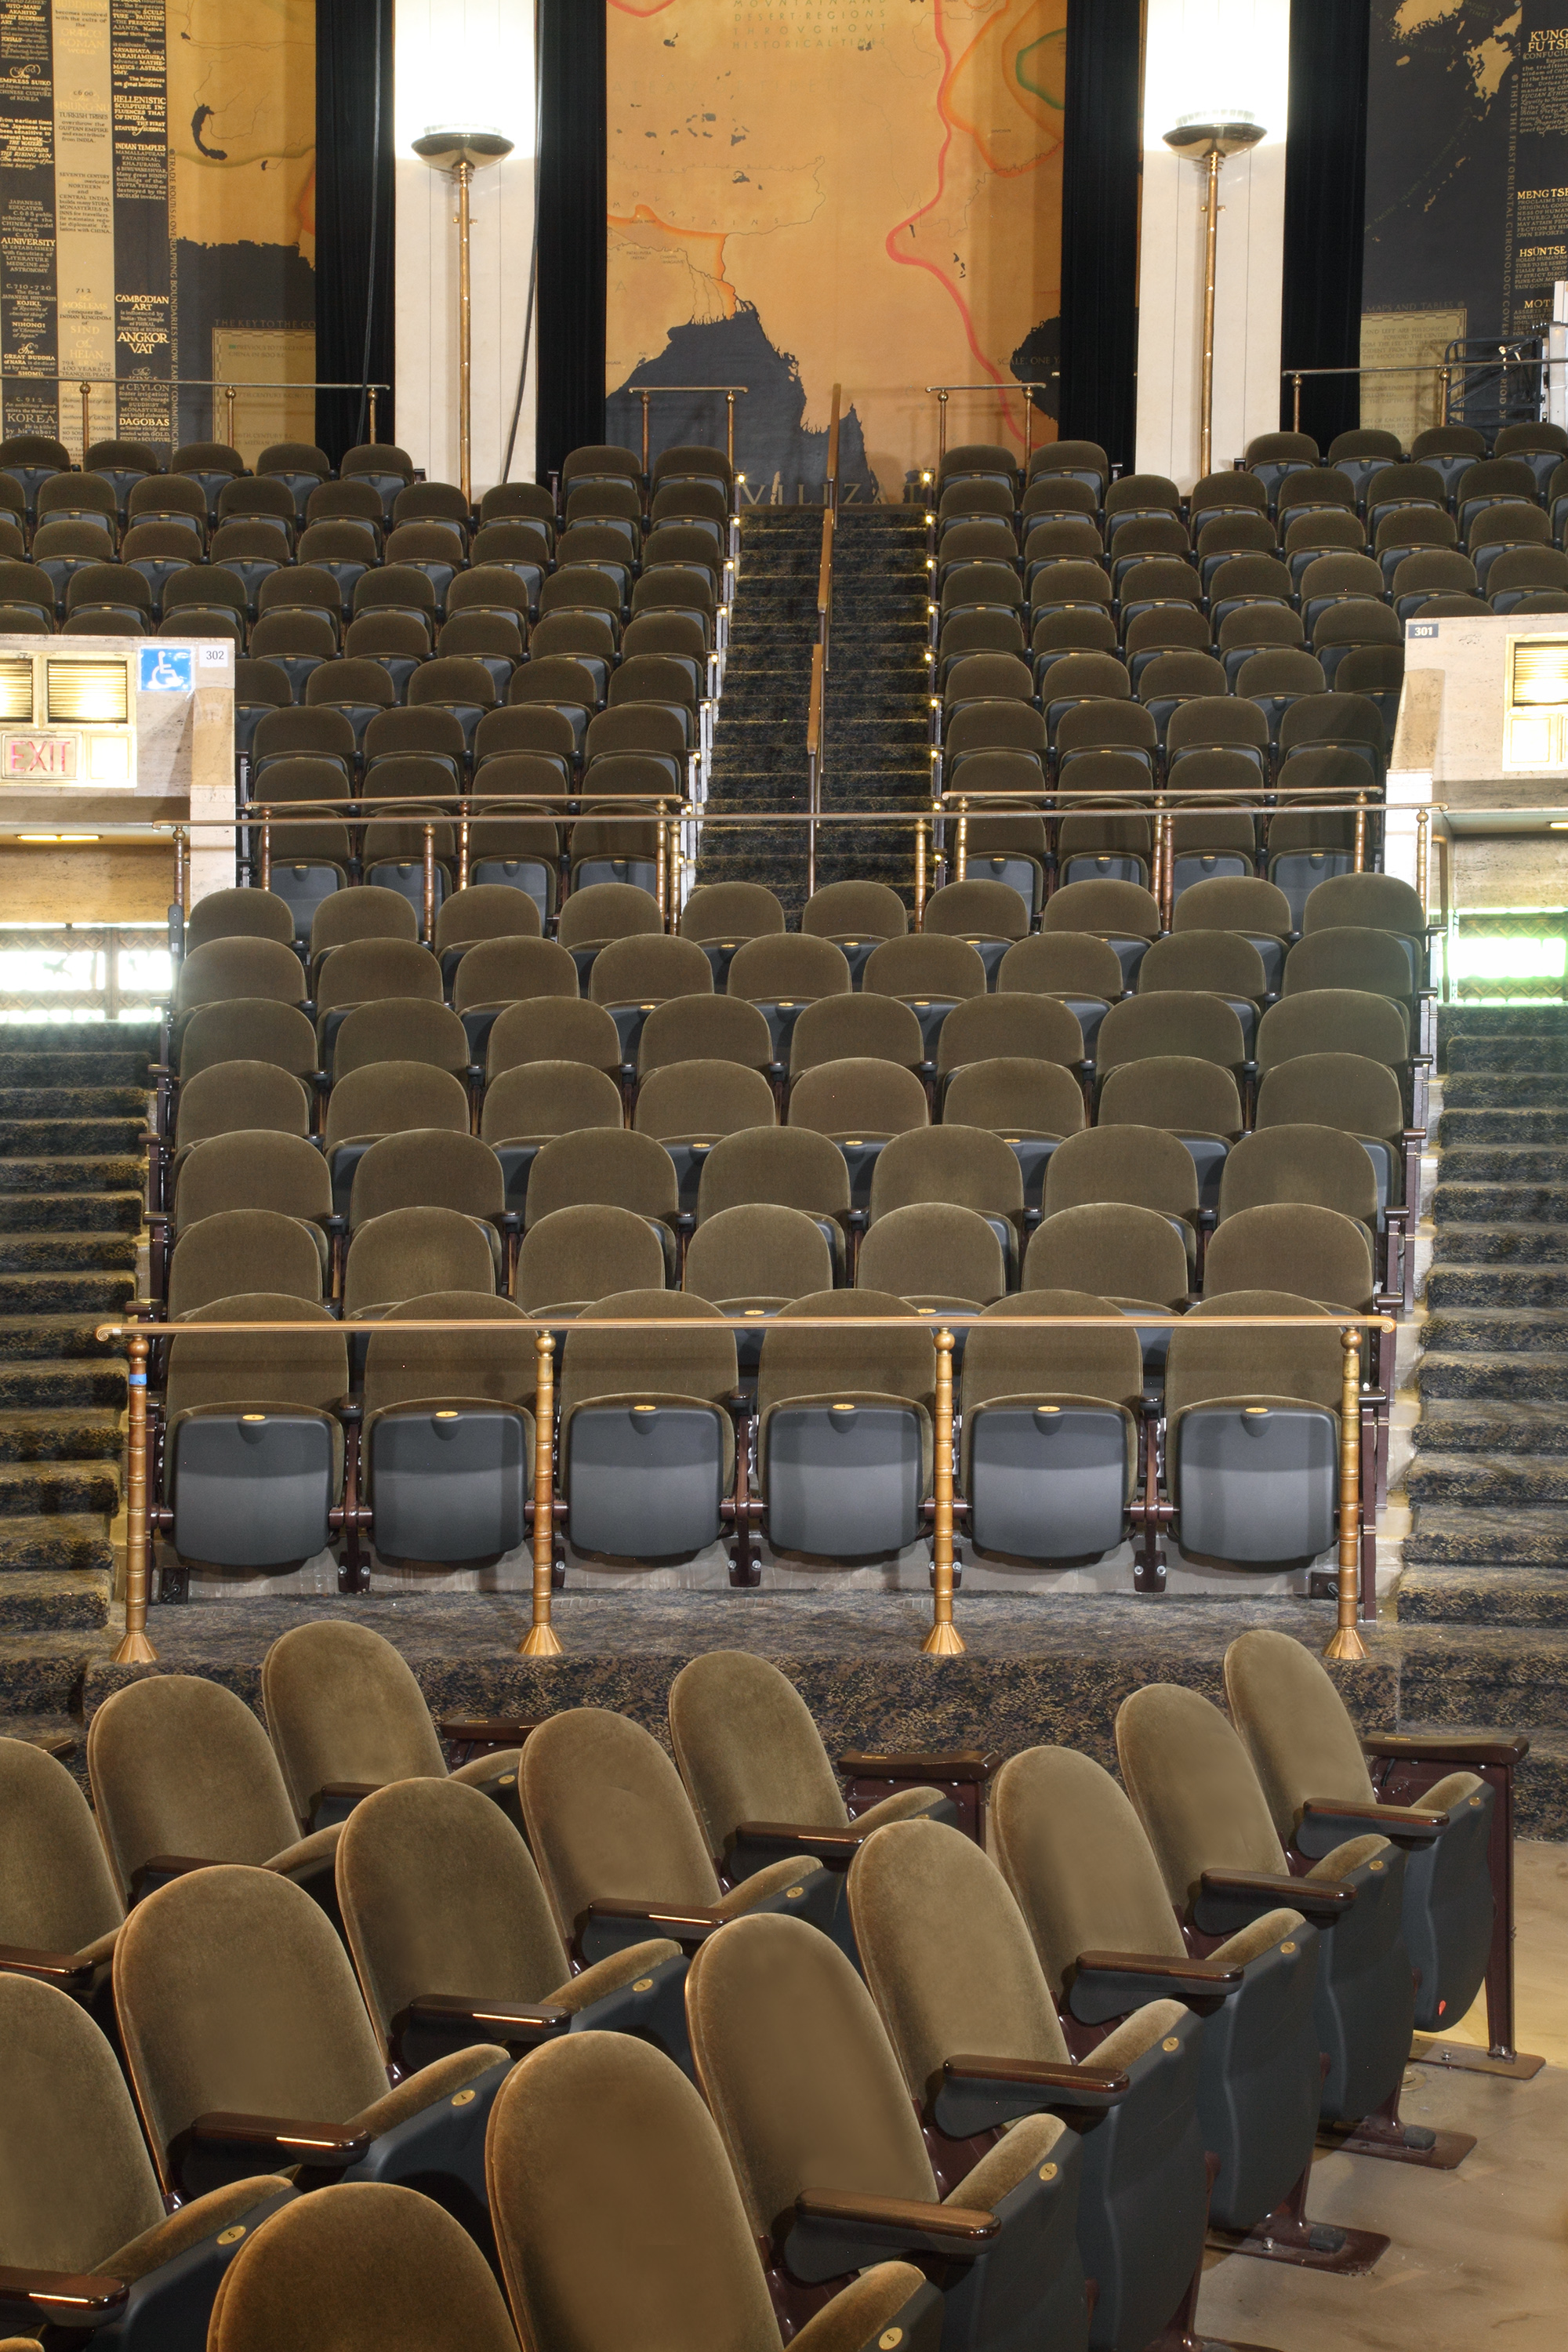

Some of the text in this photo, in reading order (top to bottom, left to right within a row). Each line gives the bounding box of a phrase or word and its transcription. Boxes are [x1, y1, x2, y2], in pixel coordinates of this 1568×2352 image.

[59, 39, 106, 49] ROMAN
[1528, 41, 1545, 53] FU
[114, 95, 166, 104] HELLENISTIC
[1510, 83, 1519, 107] THIS
[1506, 166, 1515, 219] ORIENTAL
[1517, 189, 1549, 200] MENG
[1502, 222, 1515, 296] CHRONOLOGY
[115, 294, 169, 304] CAMBODIAN
[62, 301, 108, 310] MOSLEMS
[1396, 303, 1417, 311] AND
[1421, 301, 1454, 310] TABLES
[214, 318, 234, 327] THE
[238, 319, 260, 328] KEY
[71, 325, 100, 334] SIND
[117, 332, 169, 343] ANGKOR
[129, 343, 155, 354] VAT
[70, 350, 103, 359] HEIAN
[7, 413, 57, 423] KOREA.
[119, 417, 169, 426] DAGOBAS
[1415, 626, 1432, 636] 301
[206, 651, 224, 659] 302
[11, 742, 70, 771] EXIT
